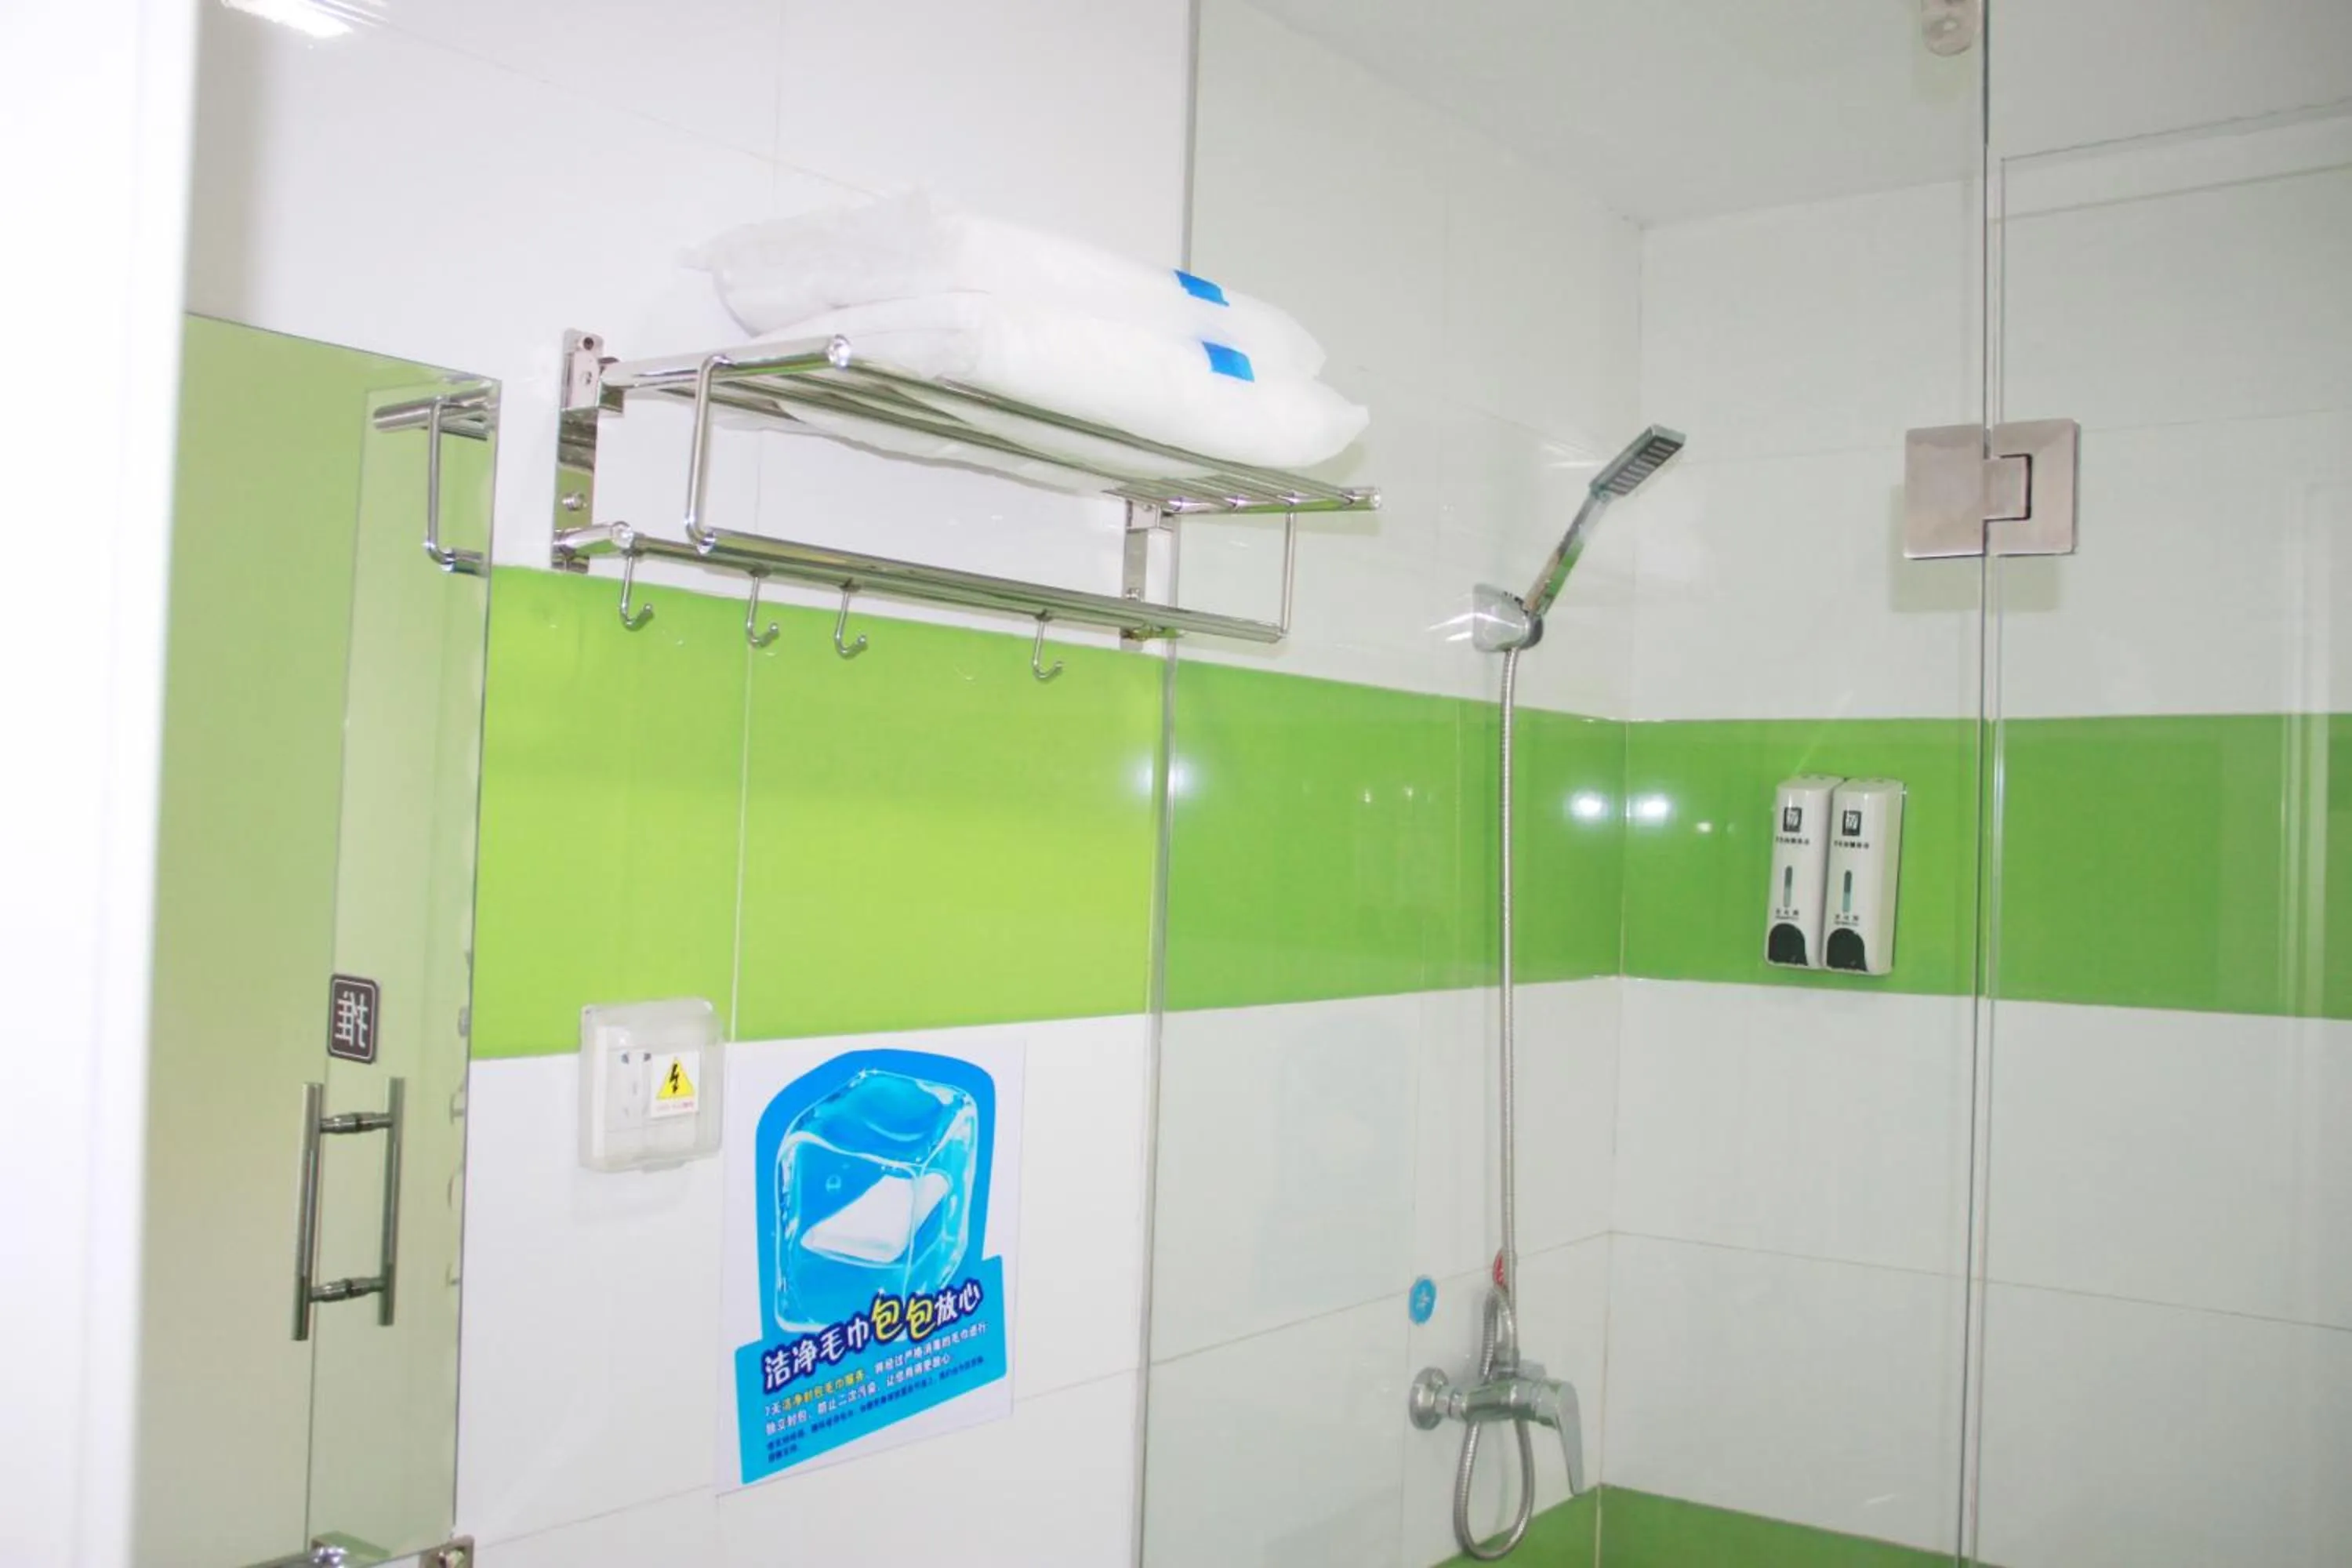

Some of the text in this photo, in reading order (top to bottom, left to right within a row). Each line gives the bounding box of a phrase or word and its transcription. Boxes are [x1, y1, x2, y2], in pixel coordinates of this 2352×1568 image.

[764, 1282, 982, 1390] 洁净毛巾包包放心
